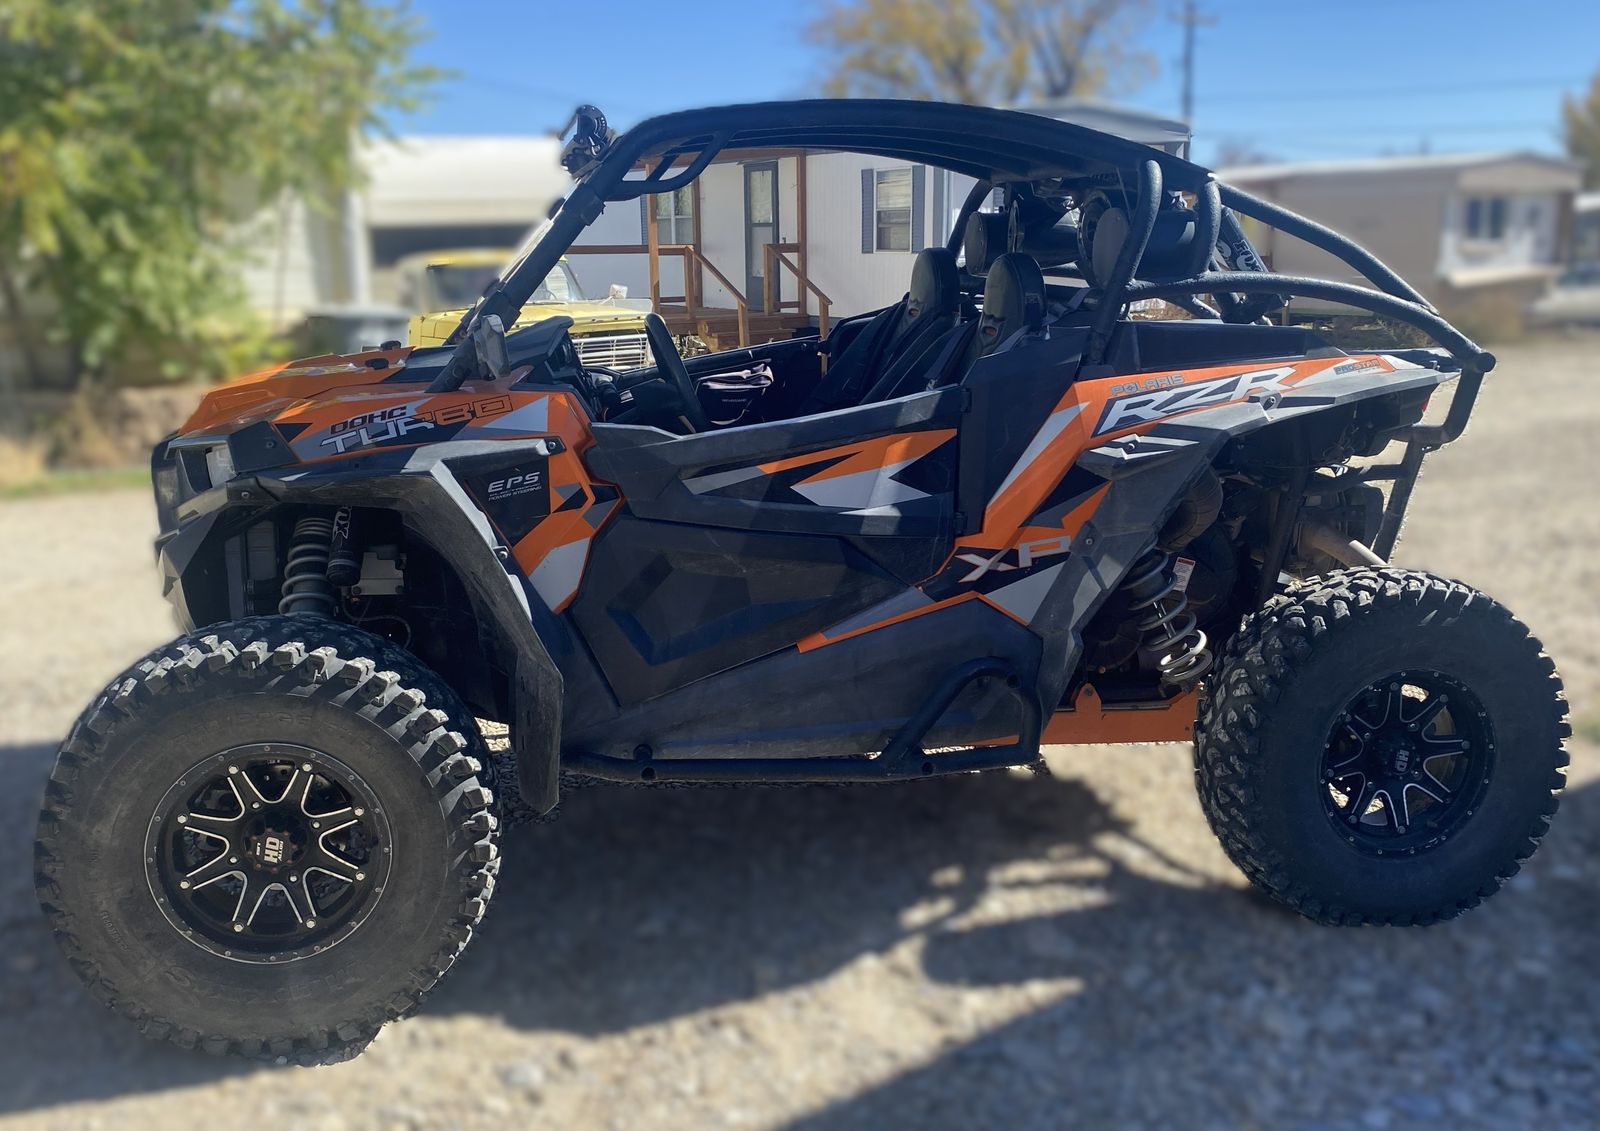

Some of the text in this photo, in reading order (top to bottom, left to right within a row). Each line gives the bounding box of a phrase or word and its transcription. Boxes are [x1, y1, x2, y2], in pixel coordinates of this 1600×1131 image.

[1110, 374, 1185, 397] POLARIS
[1096, 366, 1297, 436] RZR
[320, 394, 513, 454] TURBO
[330, 405, 408, 435] DOHC
[487, 471, 541, 493] EPS
[332, 505, 352, 543] OX
[954, 535, 1071, 584] XP
[1397, 749, 1409, 772] HD
[263, 836, 280, 864] HD
